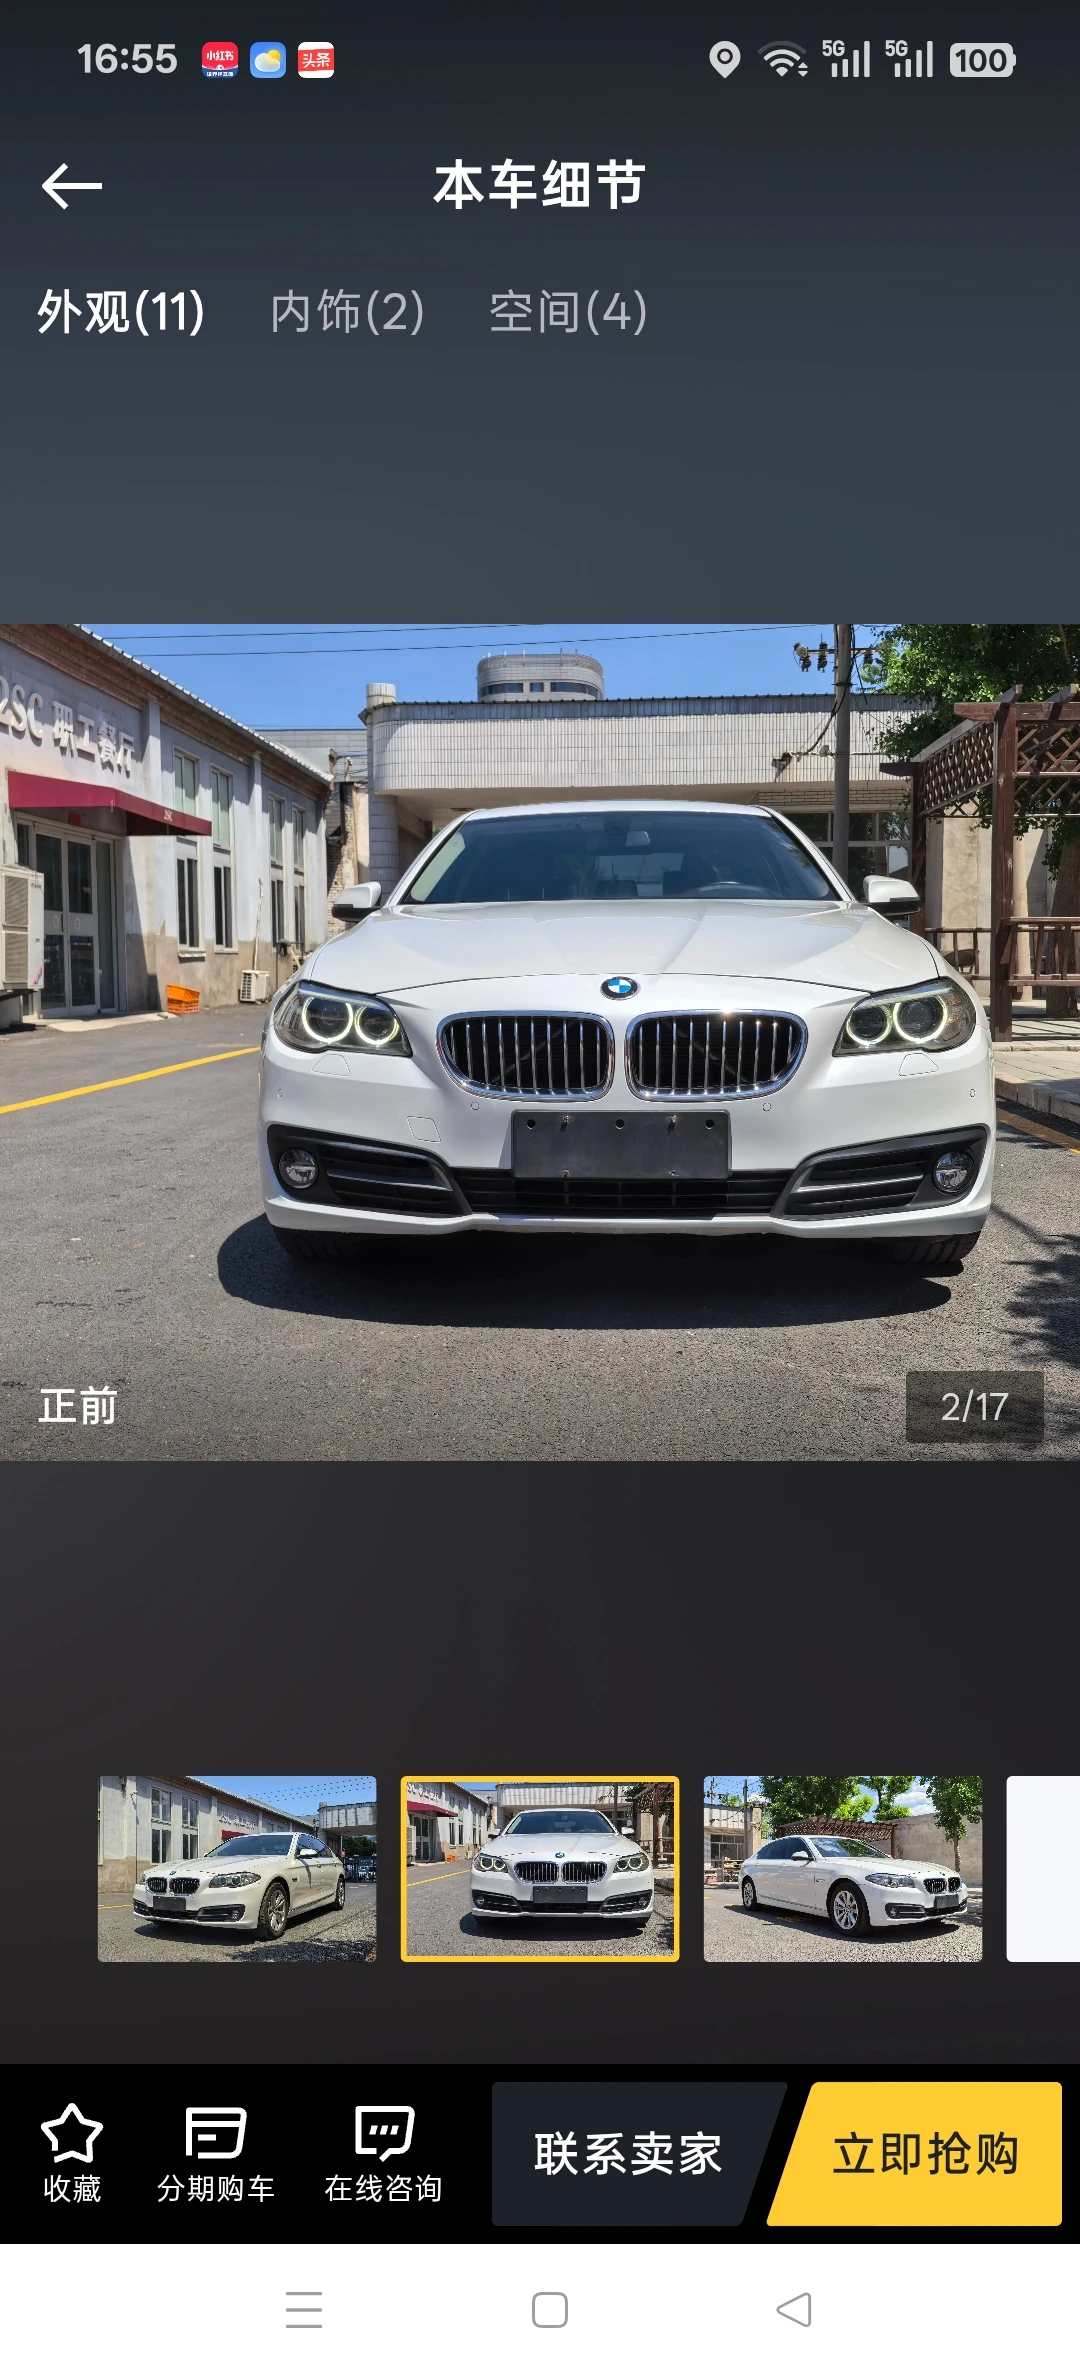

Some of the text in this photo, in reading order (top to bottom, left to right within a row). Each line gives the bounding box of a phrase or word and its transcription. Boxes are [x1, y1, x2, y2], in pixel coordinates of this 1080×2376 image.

[77, 43, 178, 74] 16:55
[206, 50, 234, 61] 小红书
[301, 53, 331, 69] 头条
[822, 39, 846, 57] 5G
[885, 39, 909, 57] 5G
[955, 48, 1008, 73] 100
[433, 158, 646, 210] 本车细节
[37, 288, 646, 337] 外观(11) 内饰(2) 空间(4)
[52, 700, 135, 772] 职工餐厅
[534, 2130, 723, 2176] 联系卖家
[832, 2130, 1019, 2176] 立即抢购
[43, 2174, 102, 2204] 收藏
[157, 2174, 275, 2203] 分期购车
[324, 2173, 442, 2203] 在线咨询
